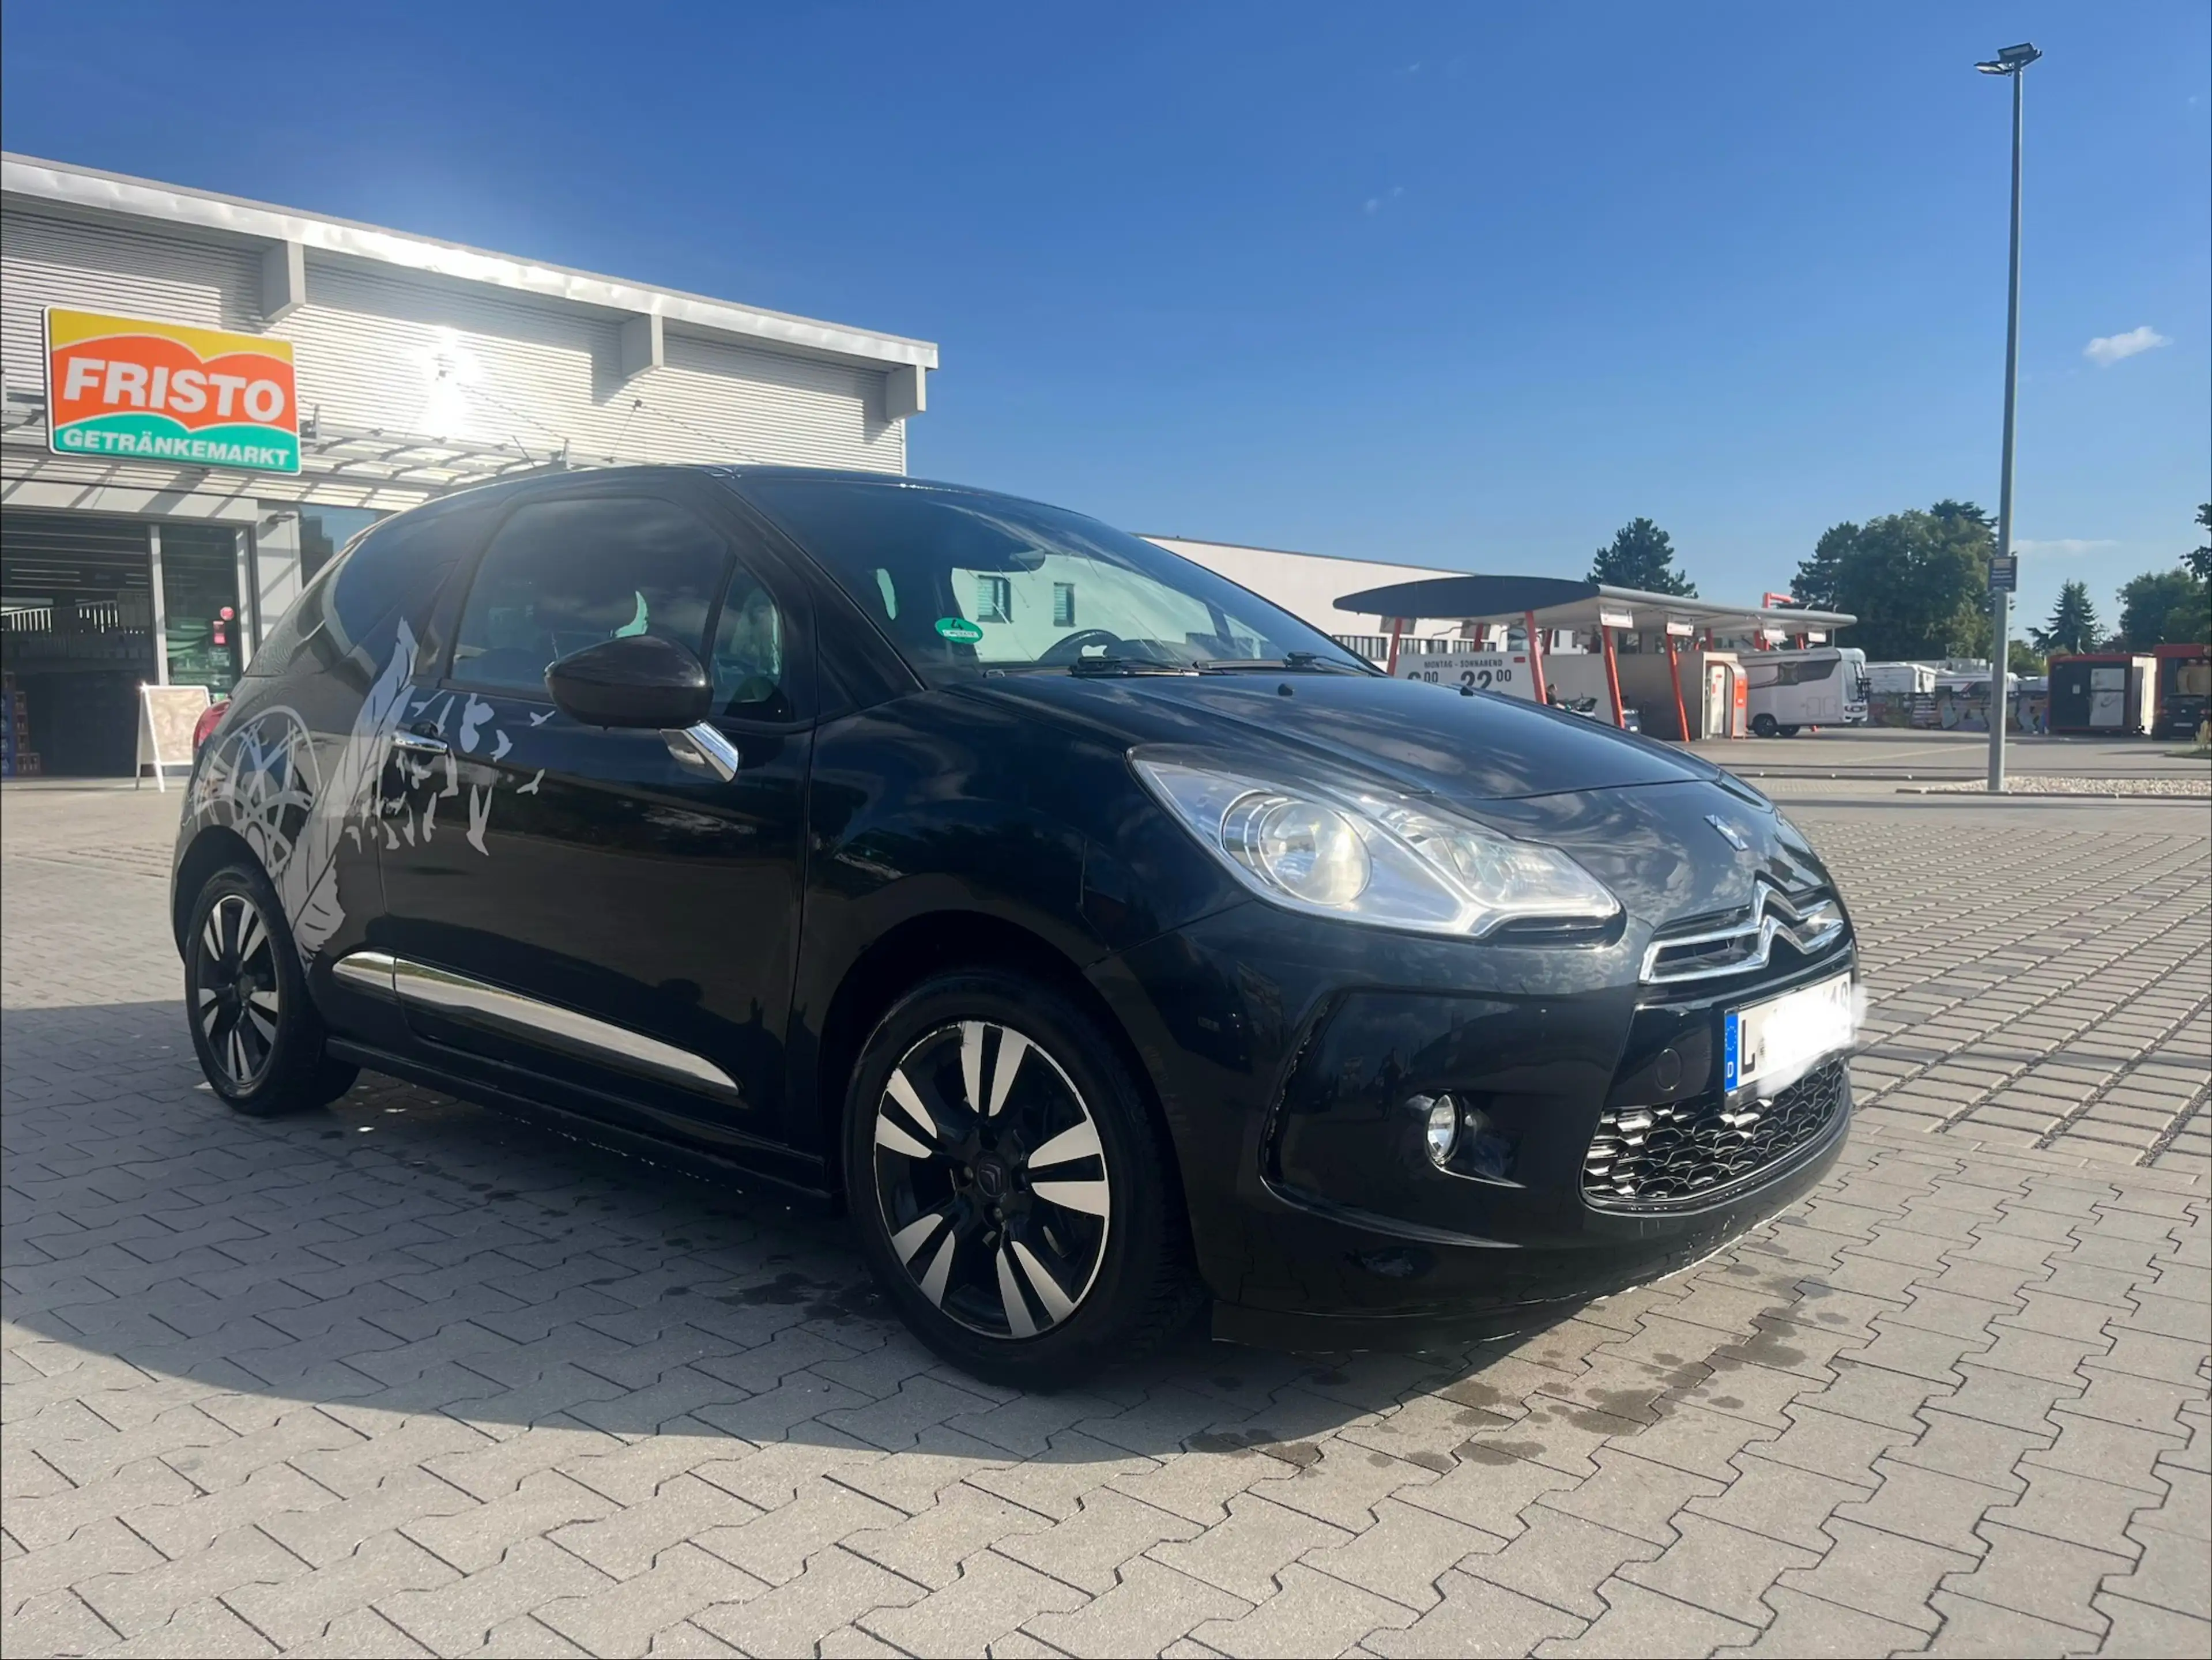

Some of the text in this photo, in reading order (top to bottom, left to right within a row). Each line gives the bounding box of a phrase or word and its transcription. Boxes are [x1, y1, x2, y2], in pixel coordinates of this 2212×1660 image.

[63, 357, 285, 422] FRISTO
[63, 428, 289, 466] GETRÄNKEMARKT
[1424, 661, 1453, 669] MONTAG
[1460, 659, 1503, 667] SONNABEND
[1727, 1061, 1734, 1078] D
